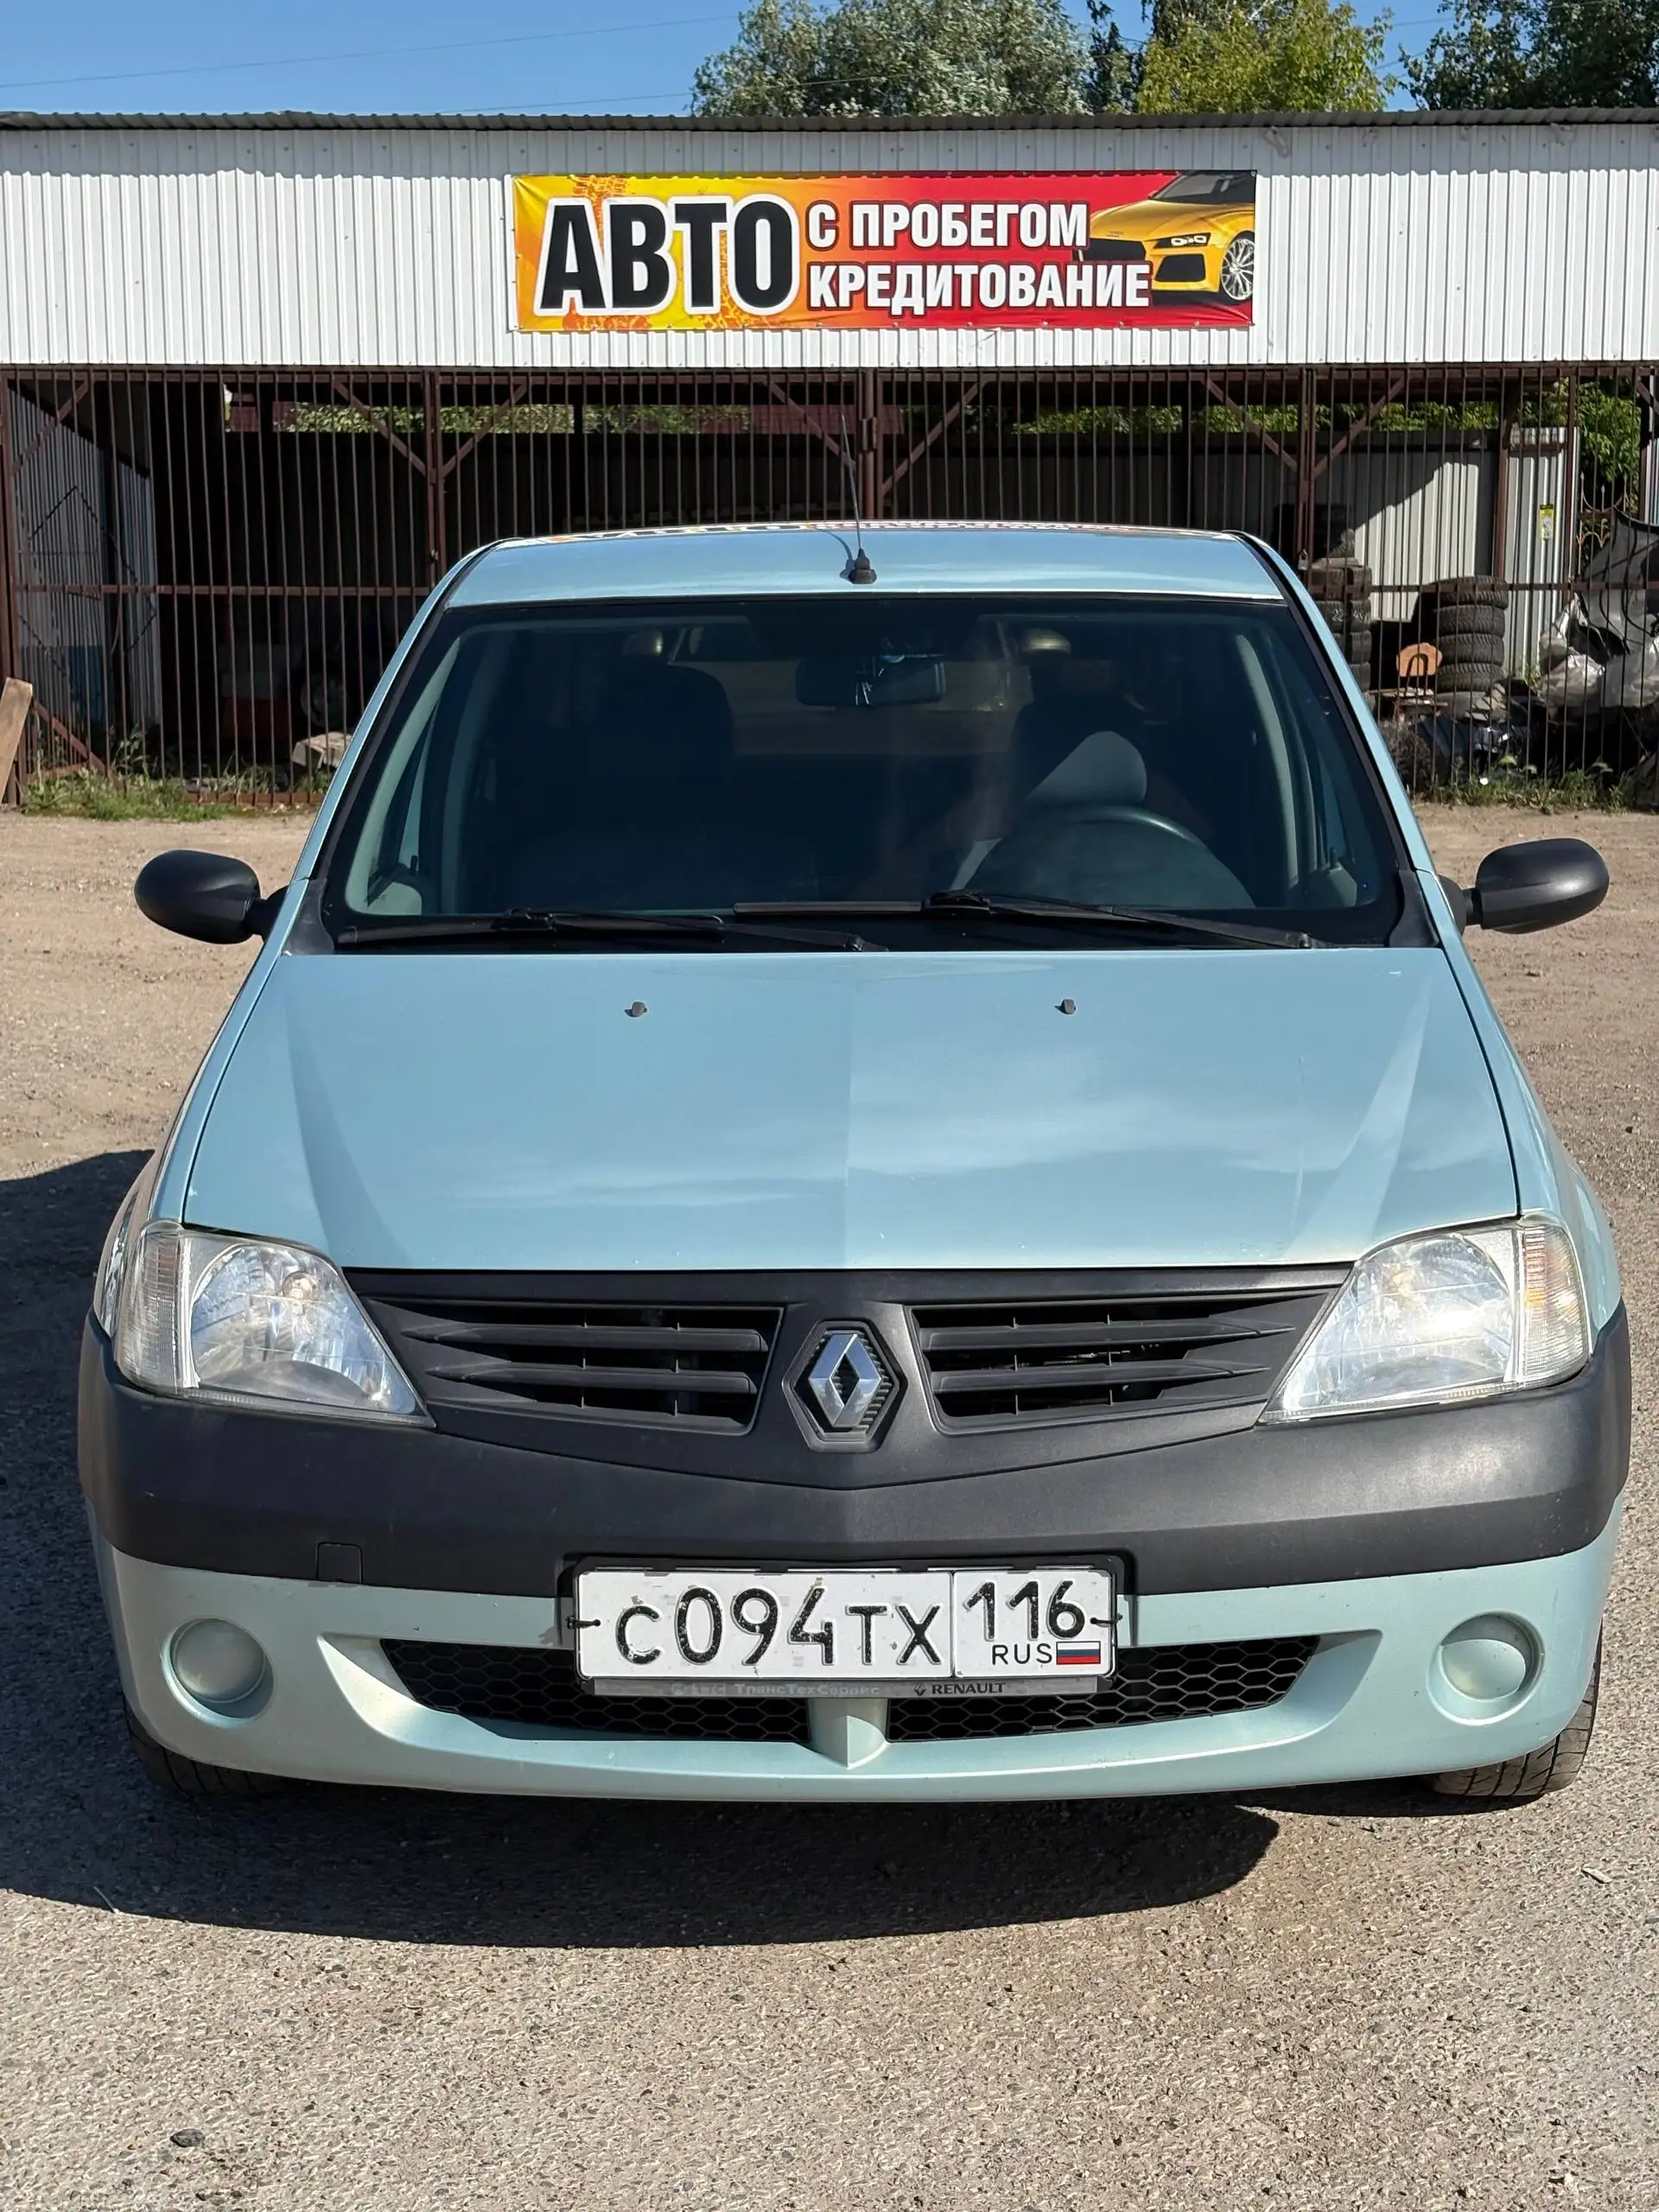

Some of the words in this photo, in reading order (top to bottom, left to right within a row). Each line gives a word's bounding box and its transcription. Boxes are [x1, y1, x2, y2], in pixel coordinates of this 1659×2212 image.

[809, 203, 838, 249] С
[852, 203, 1088, 247] ПРОБЕГОМ
[539, 198, 794, 312] АВТО
[810, 264, 1150, 314] КРЕДИТОВАНИЕ
[963, 1580, 1086, 1640] 116
[993, 1643, 1053, 1665] RUS
[931, 1682, 1006, 1694] RENAULT
